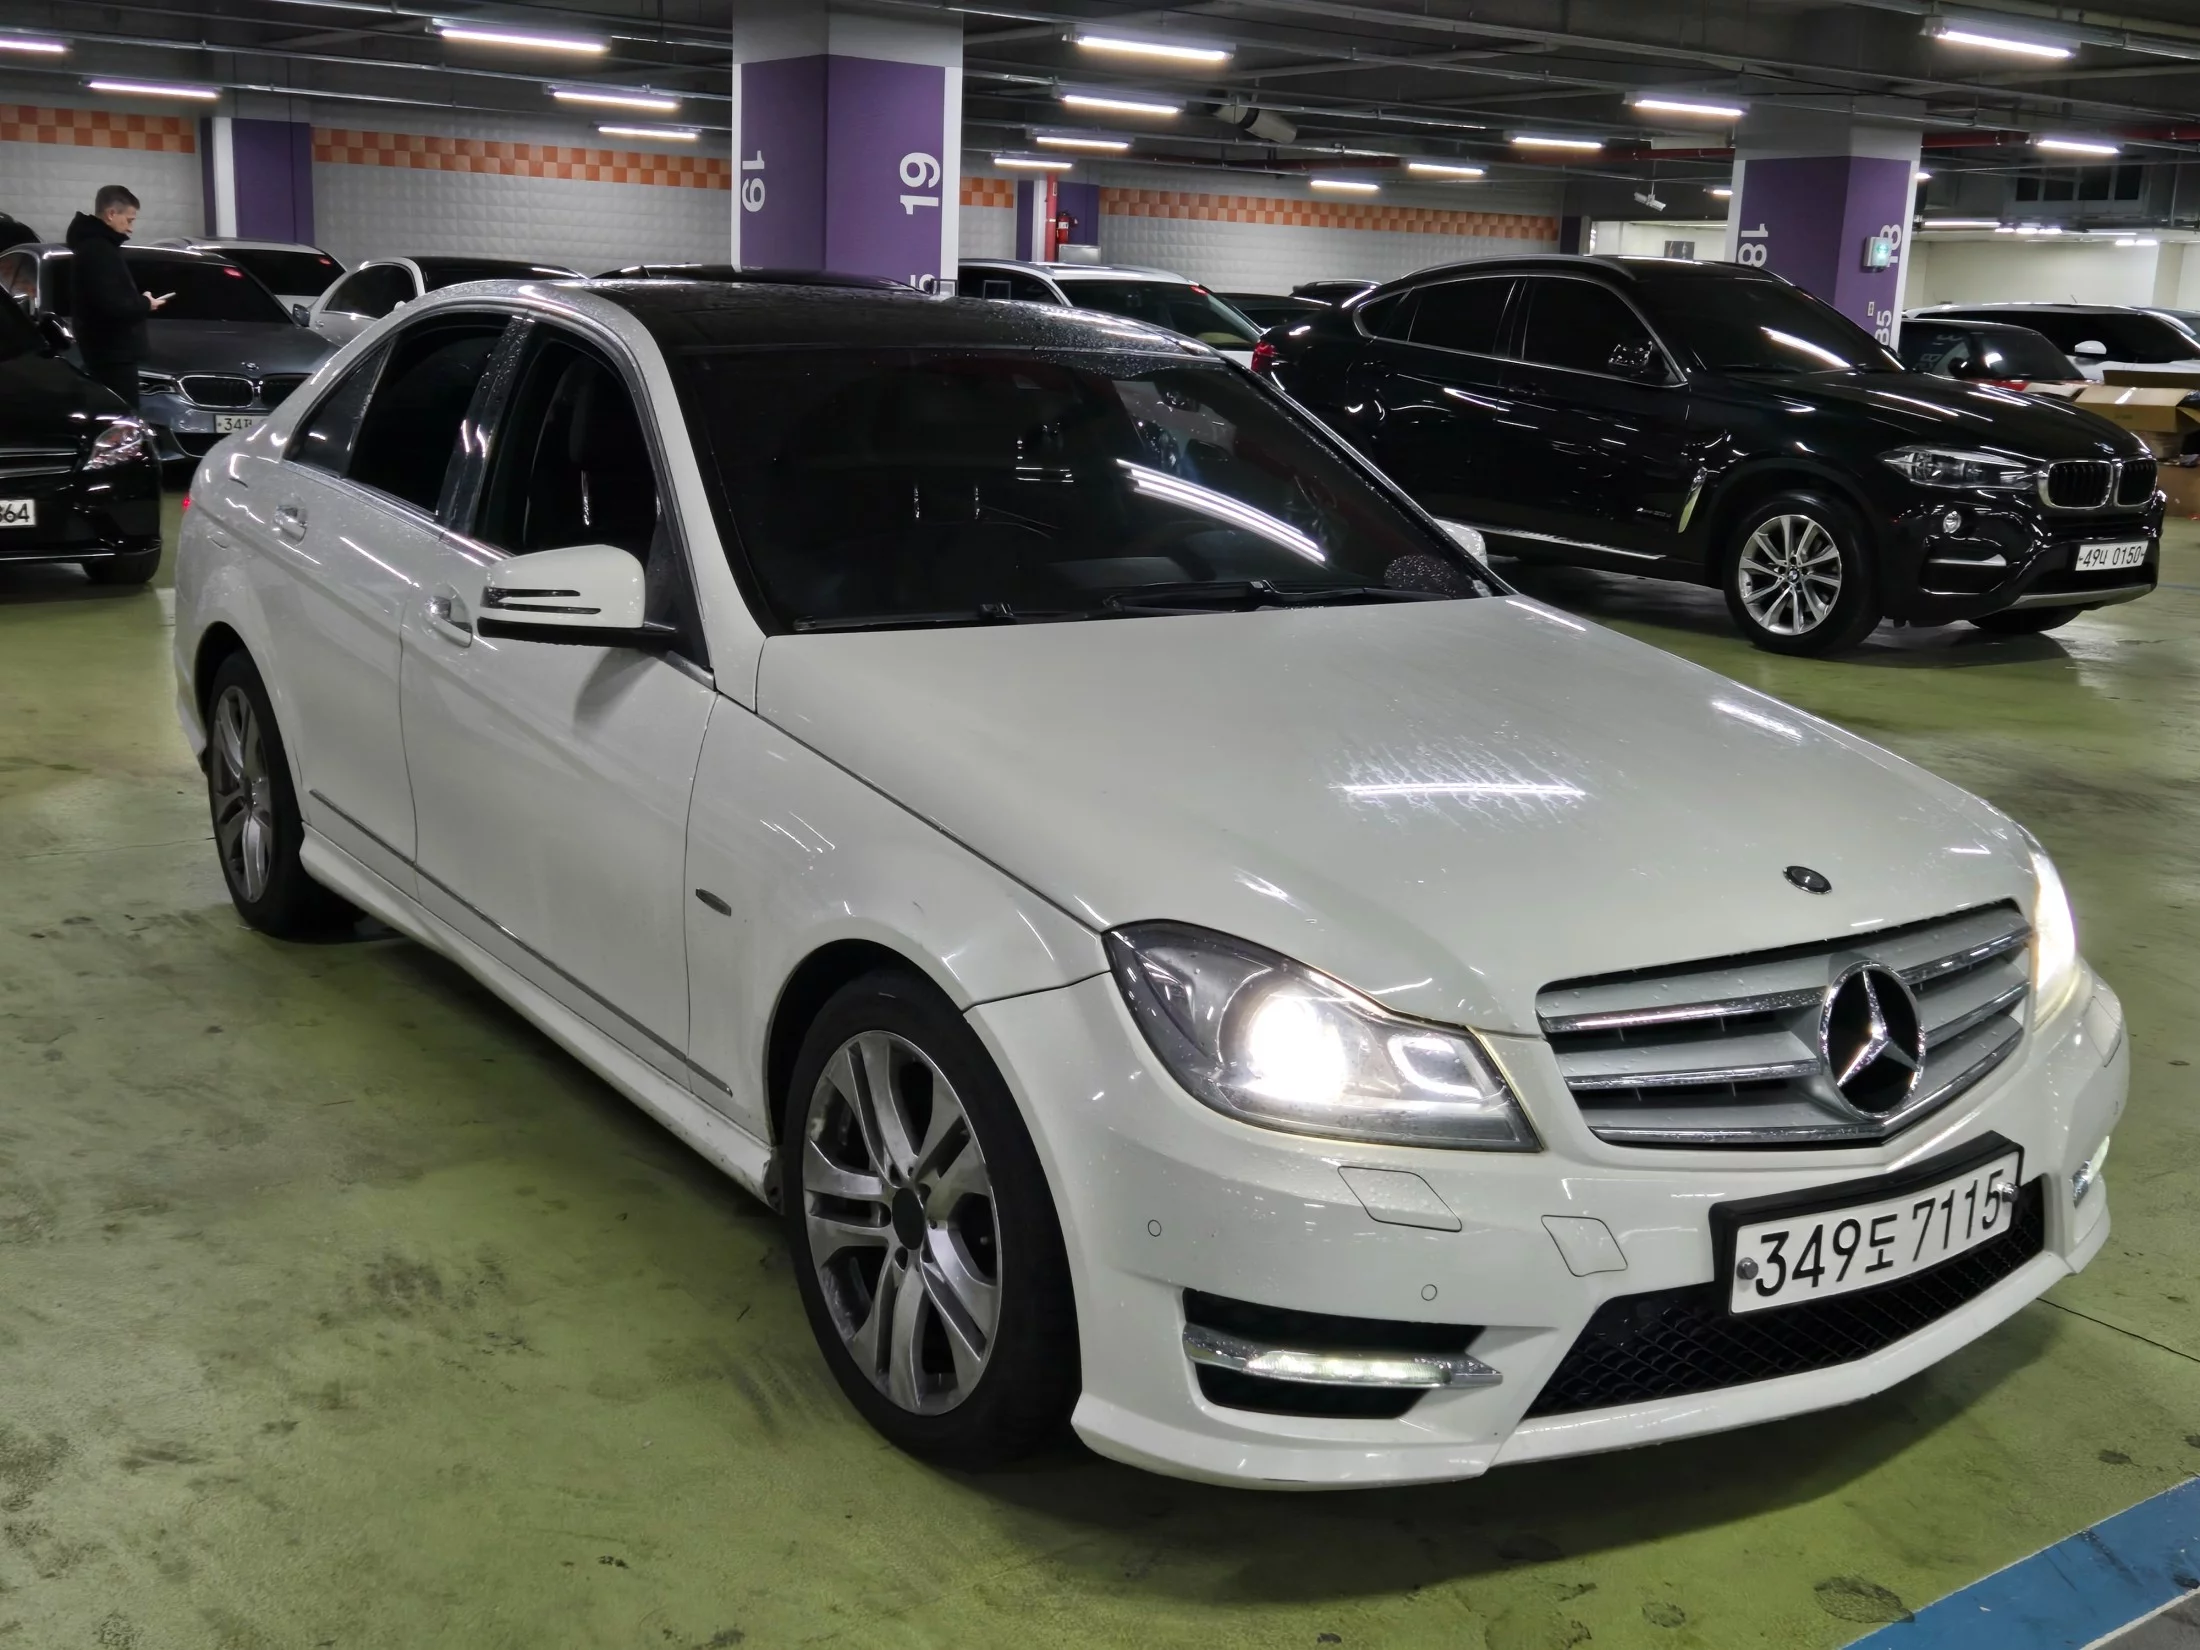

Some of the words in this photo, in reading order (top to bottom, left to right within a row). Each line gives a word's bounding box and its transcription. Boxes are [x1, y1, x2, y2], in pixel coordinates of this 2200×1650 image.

[742, 150, 766, 212] 19
[900, 152, 941, 215] 19
[1738, 223, 1768, 267] 18
[0, 502, 30, 523] 64
[2112, 546, 2142, 565] 0150
[1755, 1213, 1898, 1297] 349도
[1912, 1168, 2004, 1262] 7115
